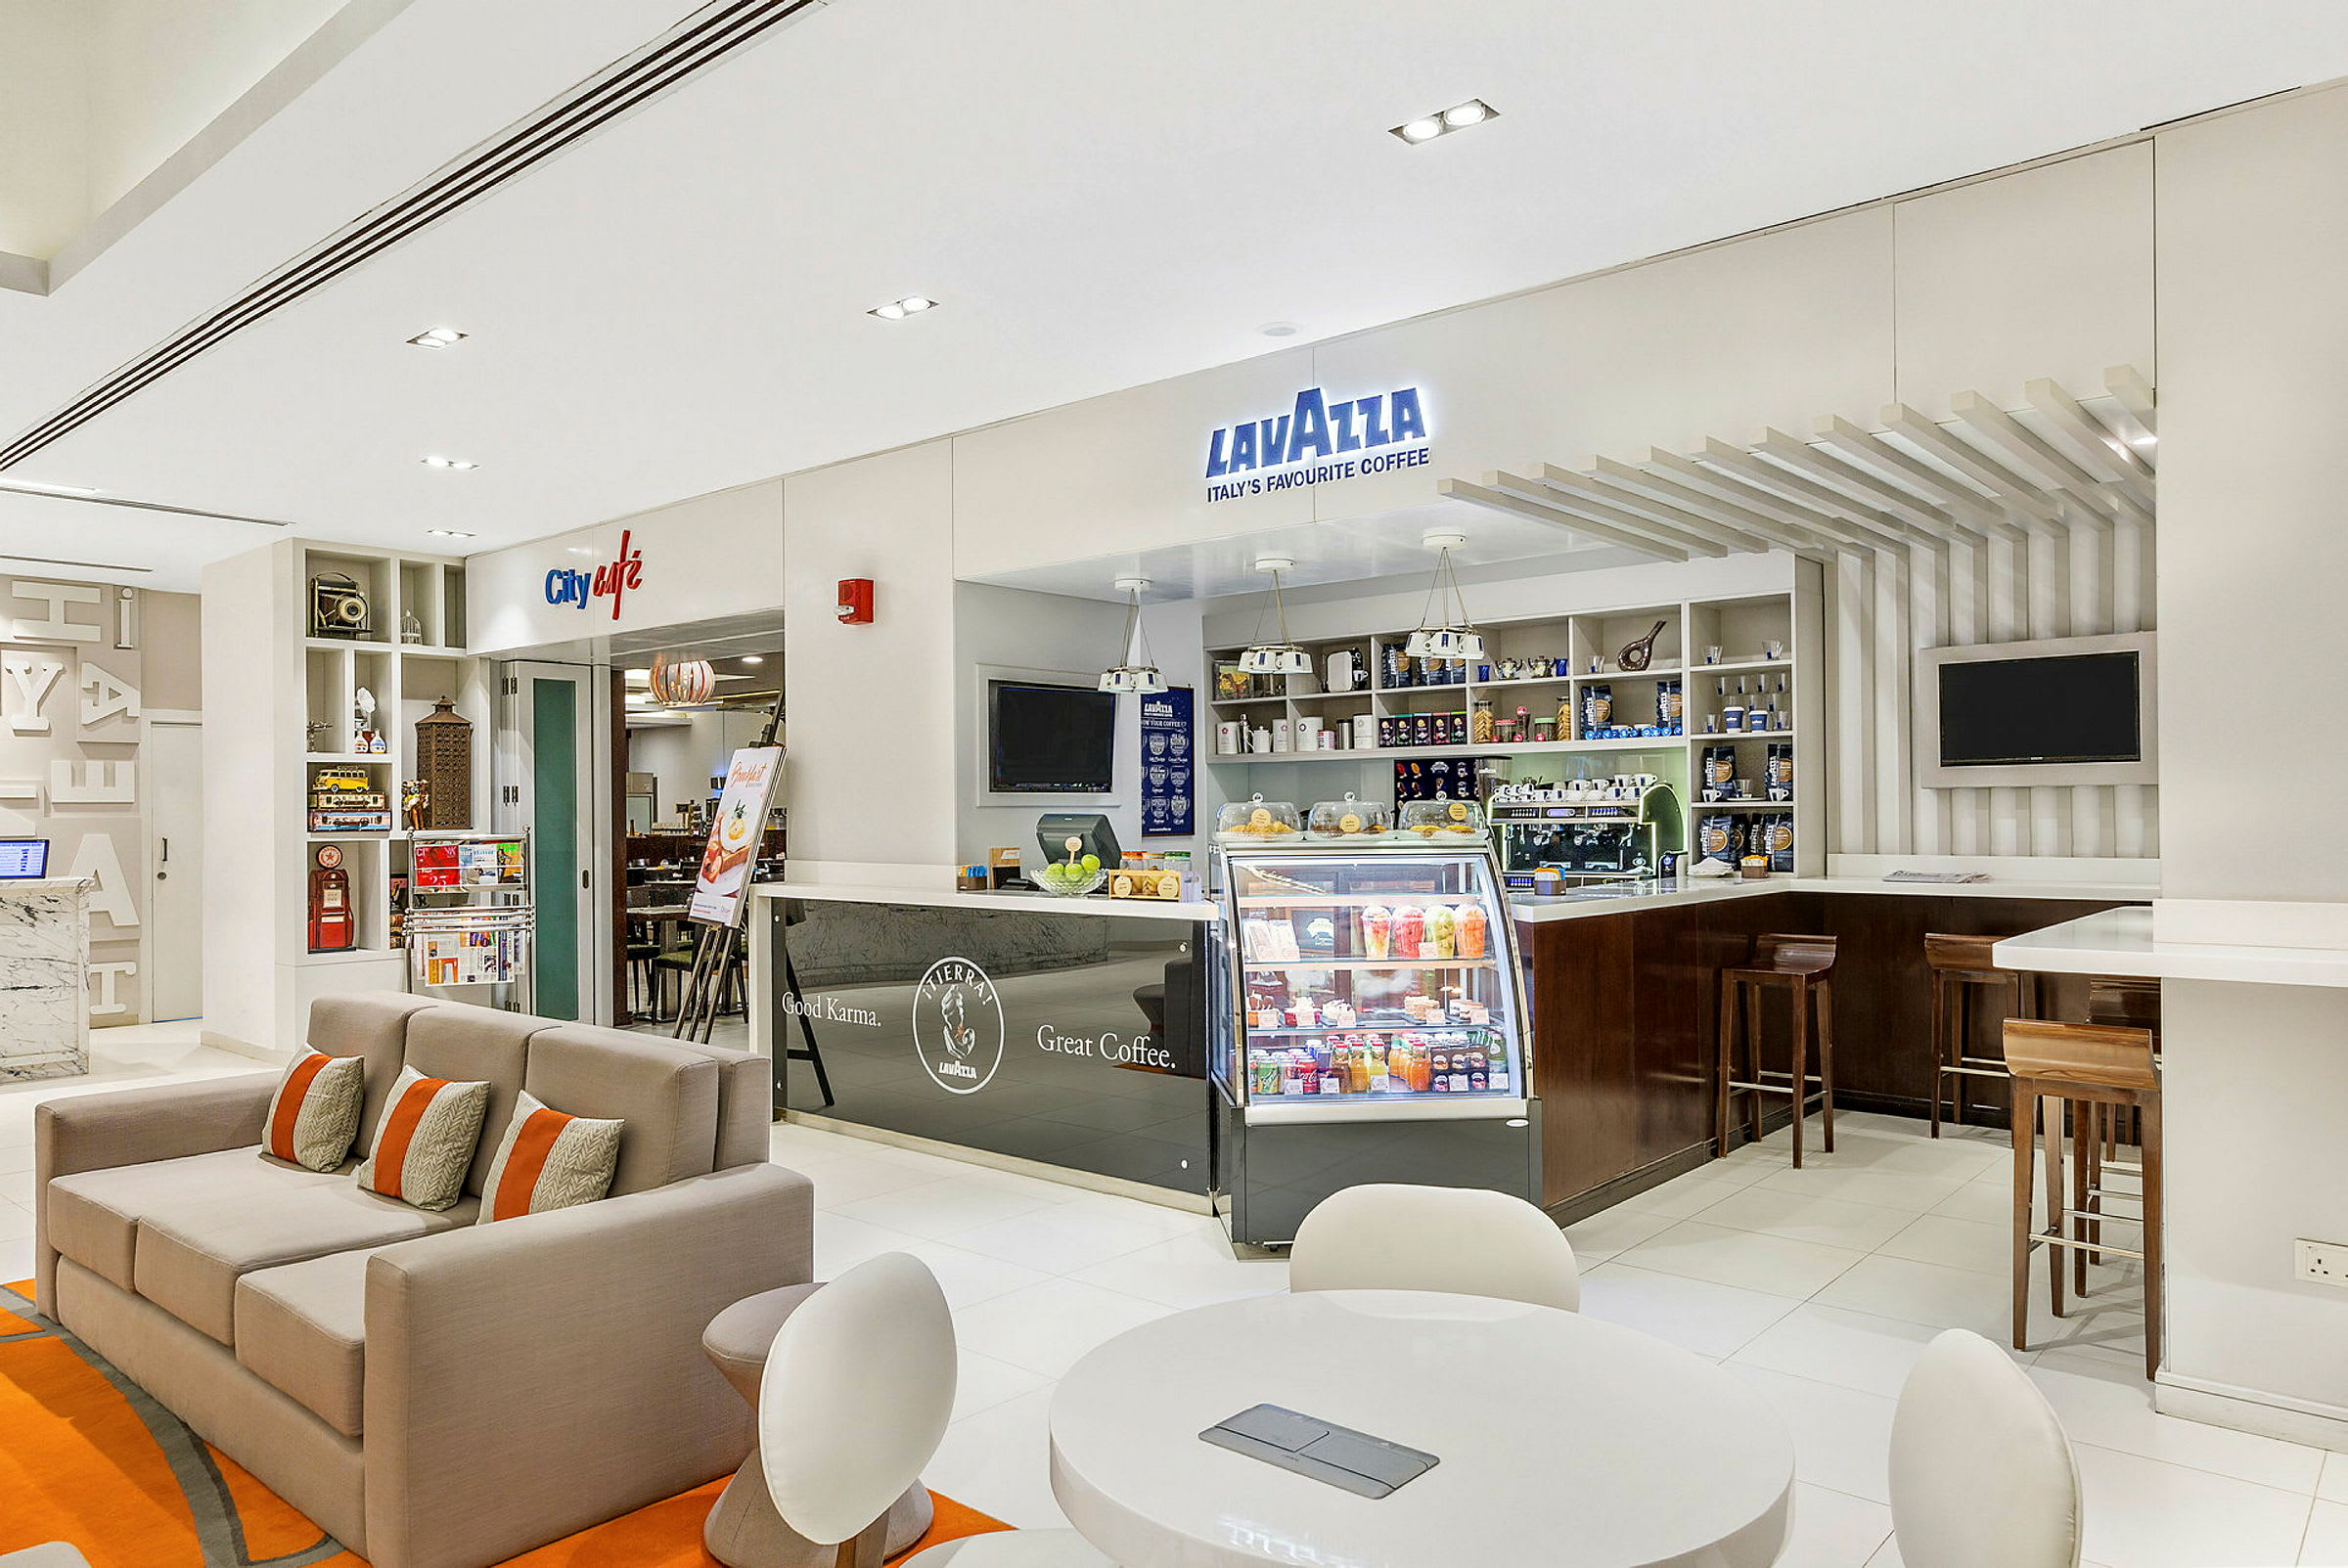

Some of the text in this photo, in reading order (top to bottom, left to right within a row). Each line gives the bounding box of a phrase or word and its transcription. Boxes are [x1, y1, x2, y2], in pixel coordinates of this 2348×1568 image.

[1206, 387, 1426, 478] LAVAZZA
[1207, 447, 1429, 503] ITALY'S FAVOURITE COFFEE
[545, 529, 643, 620] City café
[5, 661, 65, 732] Y
[782, 991, 881, 1027] Good Karma.
[923, 964, 993, 1007] ¡TIERRA!
[938, 1059, 977, 1080] LAVAZZA
[1037, 1024, 1176, 1069] Great Coffee.
